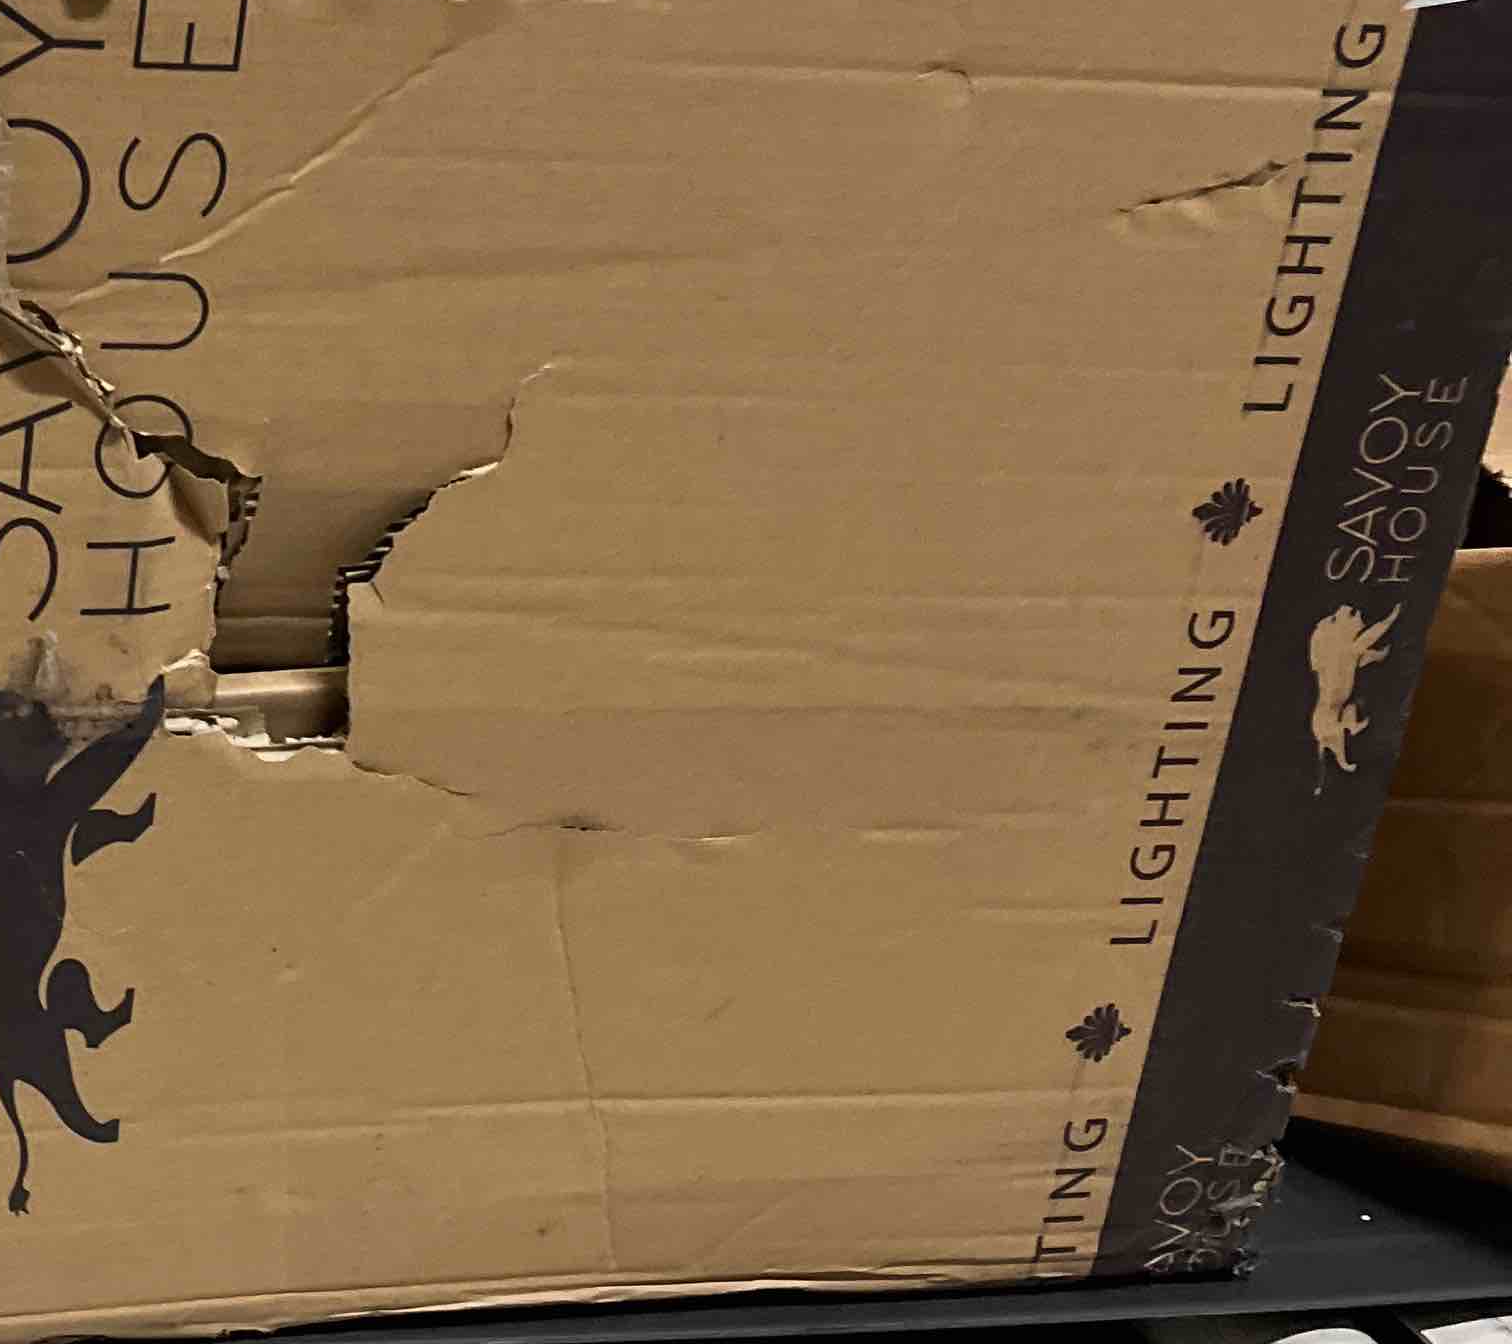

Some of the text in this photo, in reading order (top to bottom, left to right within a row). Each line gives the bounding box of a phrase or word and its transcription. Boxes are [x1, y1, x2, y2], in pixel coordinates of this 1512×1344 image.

[1242, 20, 1387, 414] LIGHTING
[1325, 372, 1423, 586] SAVOY
[1377, 375, 1470, 583] HOUSE
[1109, 609, 1236, 946] LIGHTING
[1031, 1118, 1108, 1263] TING
